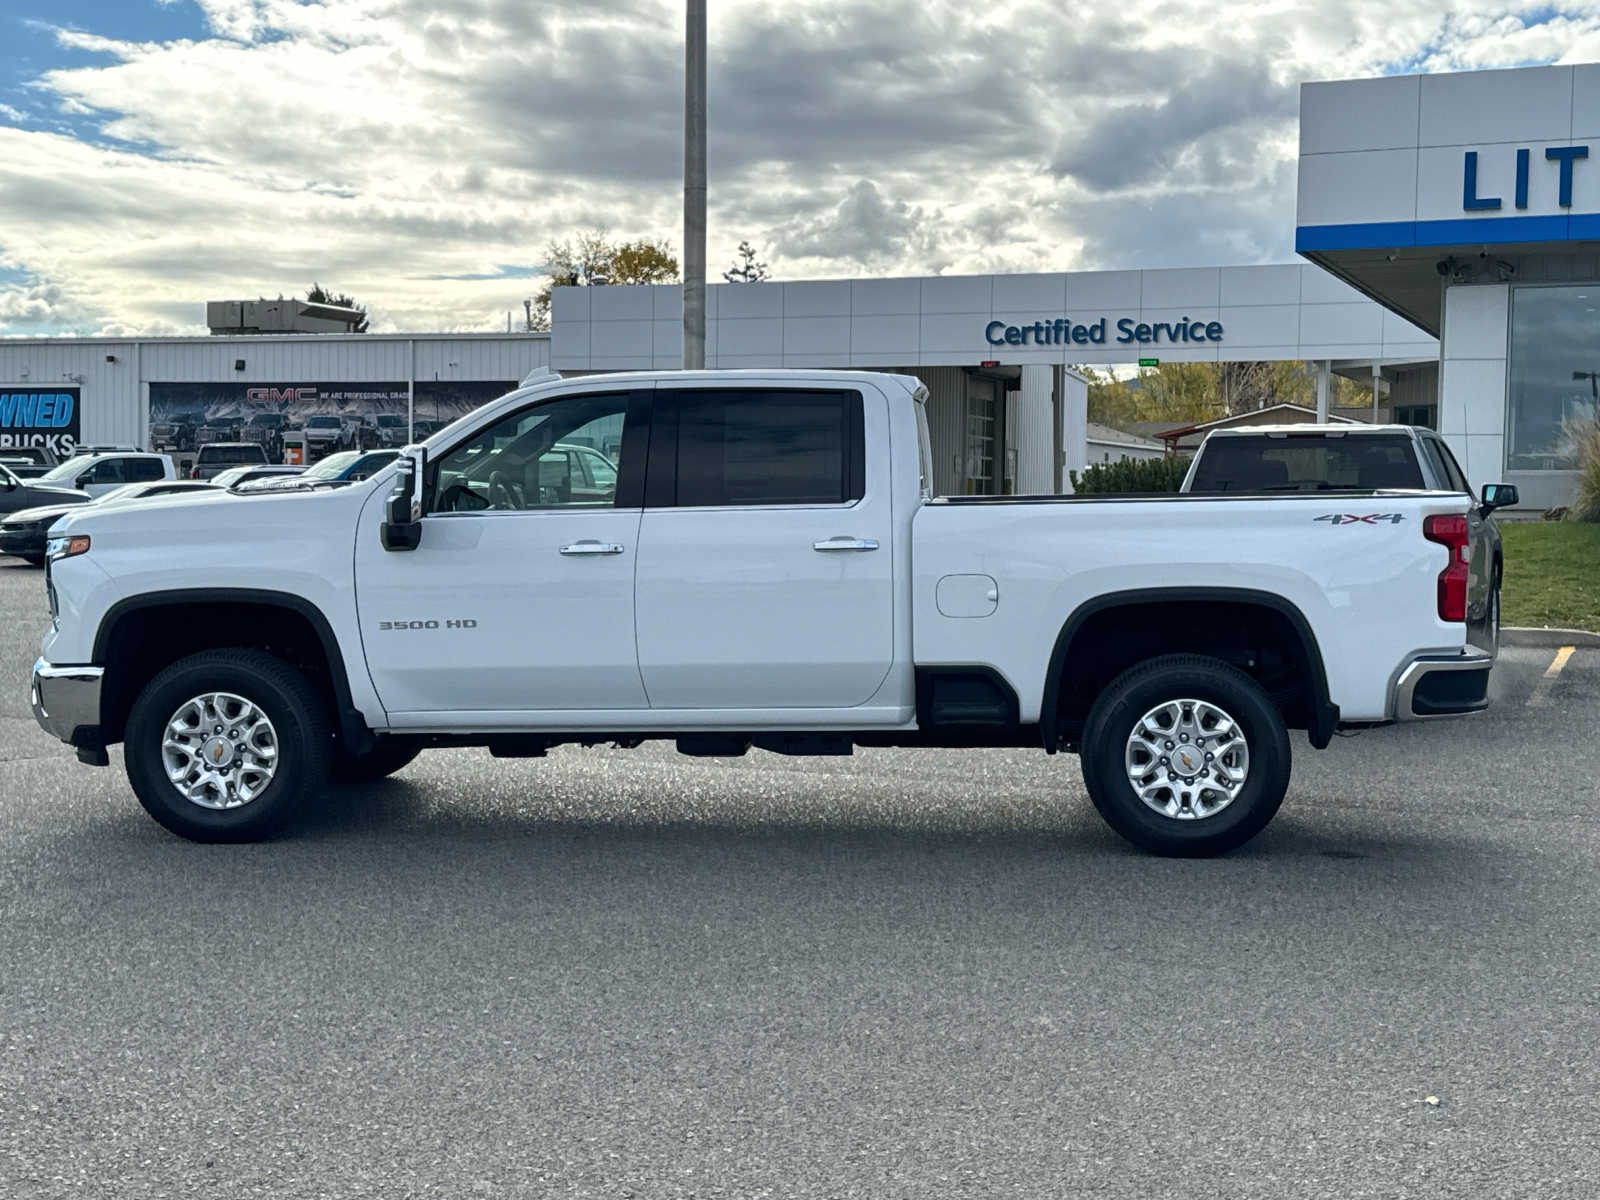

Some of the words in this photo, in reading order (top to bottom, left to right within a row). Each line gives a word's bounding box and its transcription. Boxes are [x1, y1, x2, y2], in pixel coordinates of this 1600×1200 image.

[1463, 145, 1589, 211] LIT
[985, 317, 1106, 345] Certified
[1116, 316, 1223, 343] Service
[247, 387, 317, 404] GMC
[379, 620, 440, 630] 3500
[446, 619, 478, 629] HD
